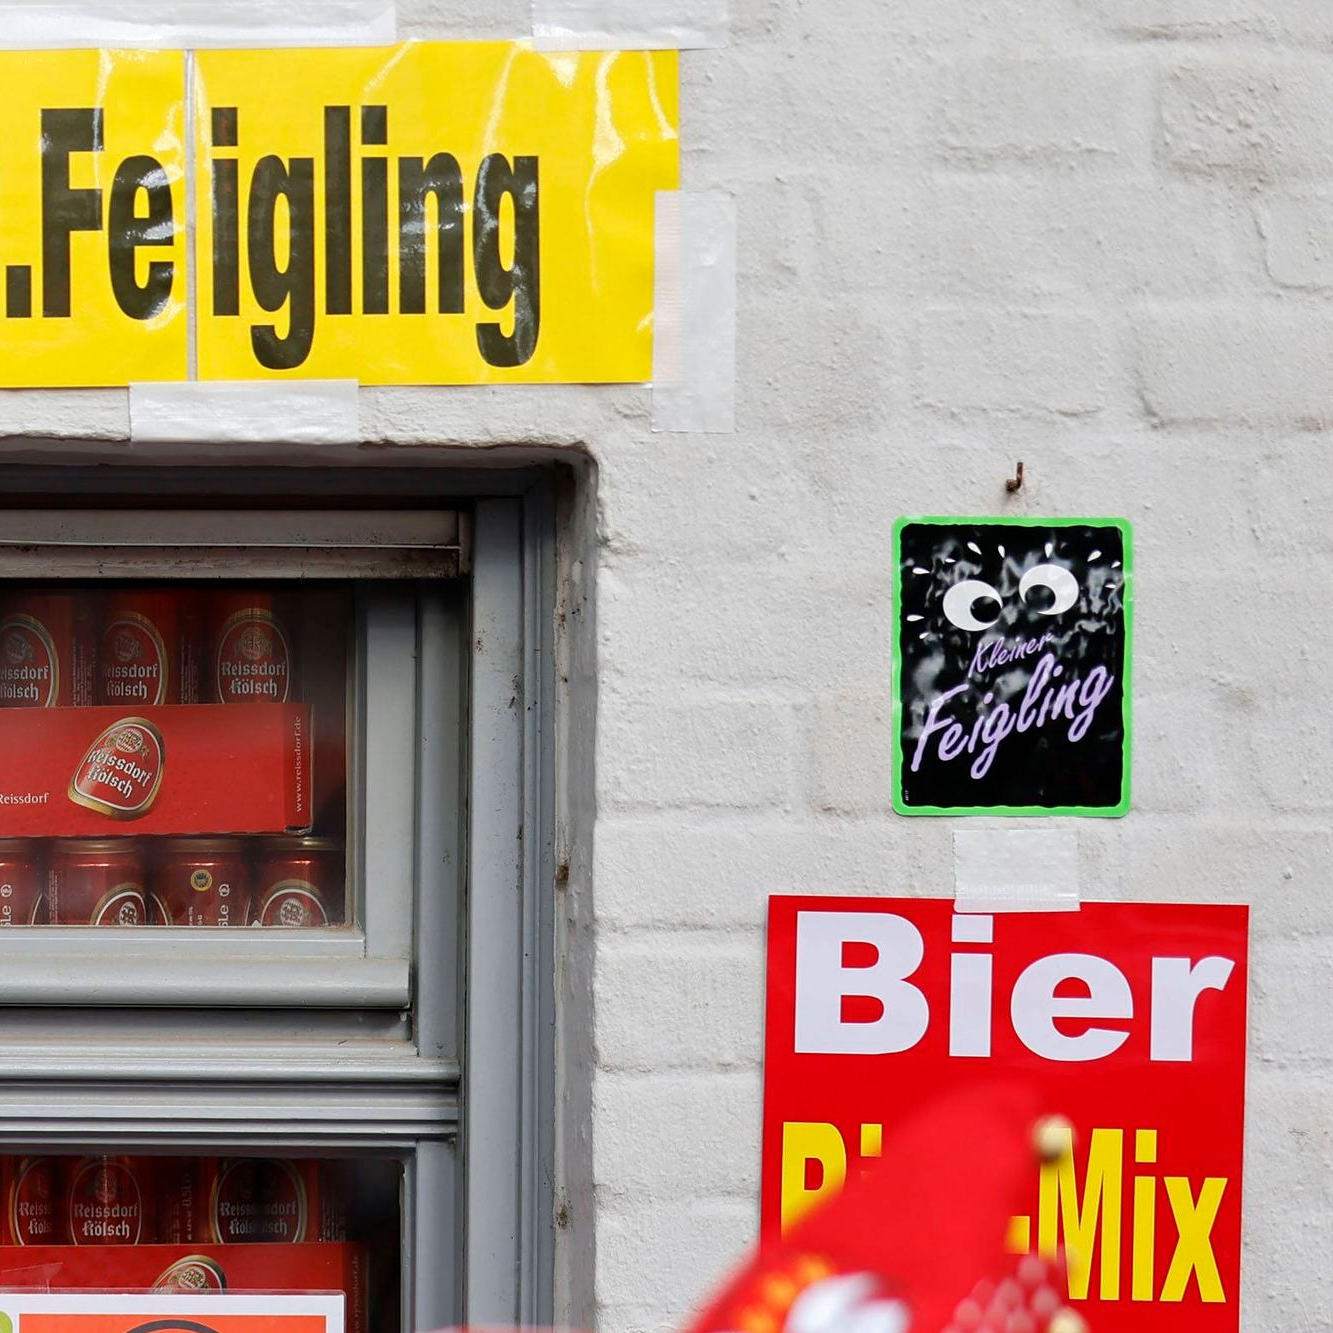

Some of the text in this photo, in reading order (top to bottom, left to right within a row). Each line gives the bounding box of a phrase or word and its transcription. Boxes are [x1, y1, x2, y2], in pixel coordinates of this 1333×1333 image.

[968, 633, 1054, 678] Kleiner
[910, 653, 1114, 779] Feigling
[85, 766, 135, 800] Kölsch
[87, 748, 152, 788] Reissdorf
[794, 910, 1236, 1061] Bier
